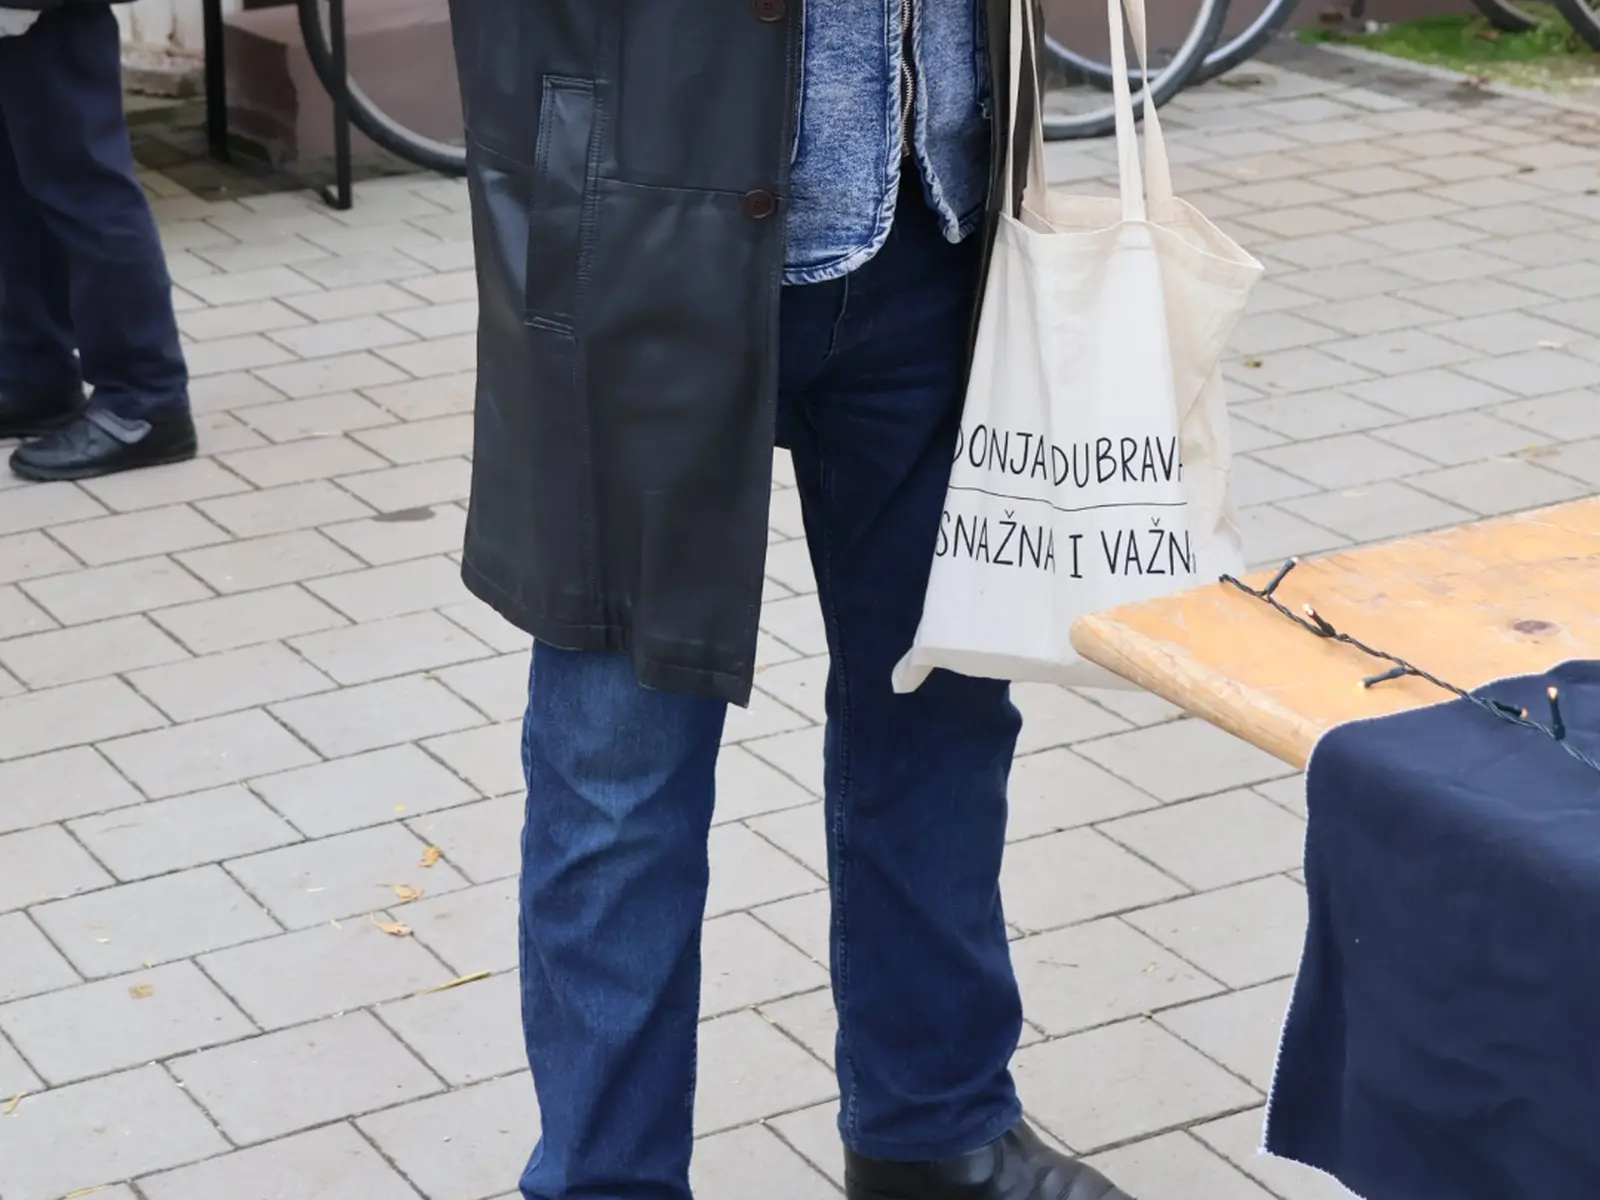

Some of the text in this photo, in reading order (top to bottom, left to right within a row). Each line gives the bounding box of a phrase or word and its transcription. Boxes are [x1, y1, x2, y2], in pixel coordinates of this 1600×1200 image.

[1051, 436, 1183, 488] DUBRAV
[1068, 534, 1083, 578] I
[1100, 516, 1196, 576] VAŽN
